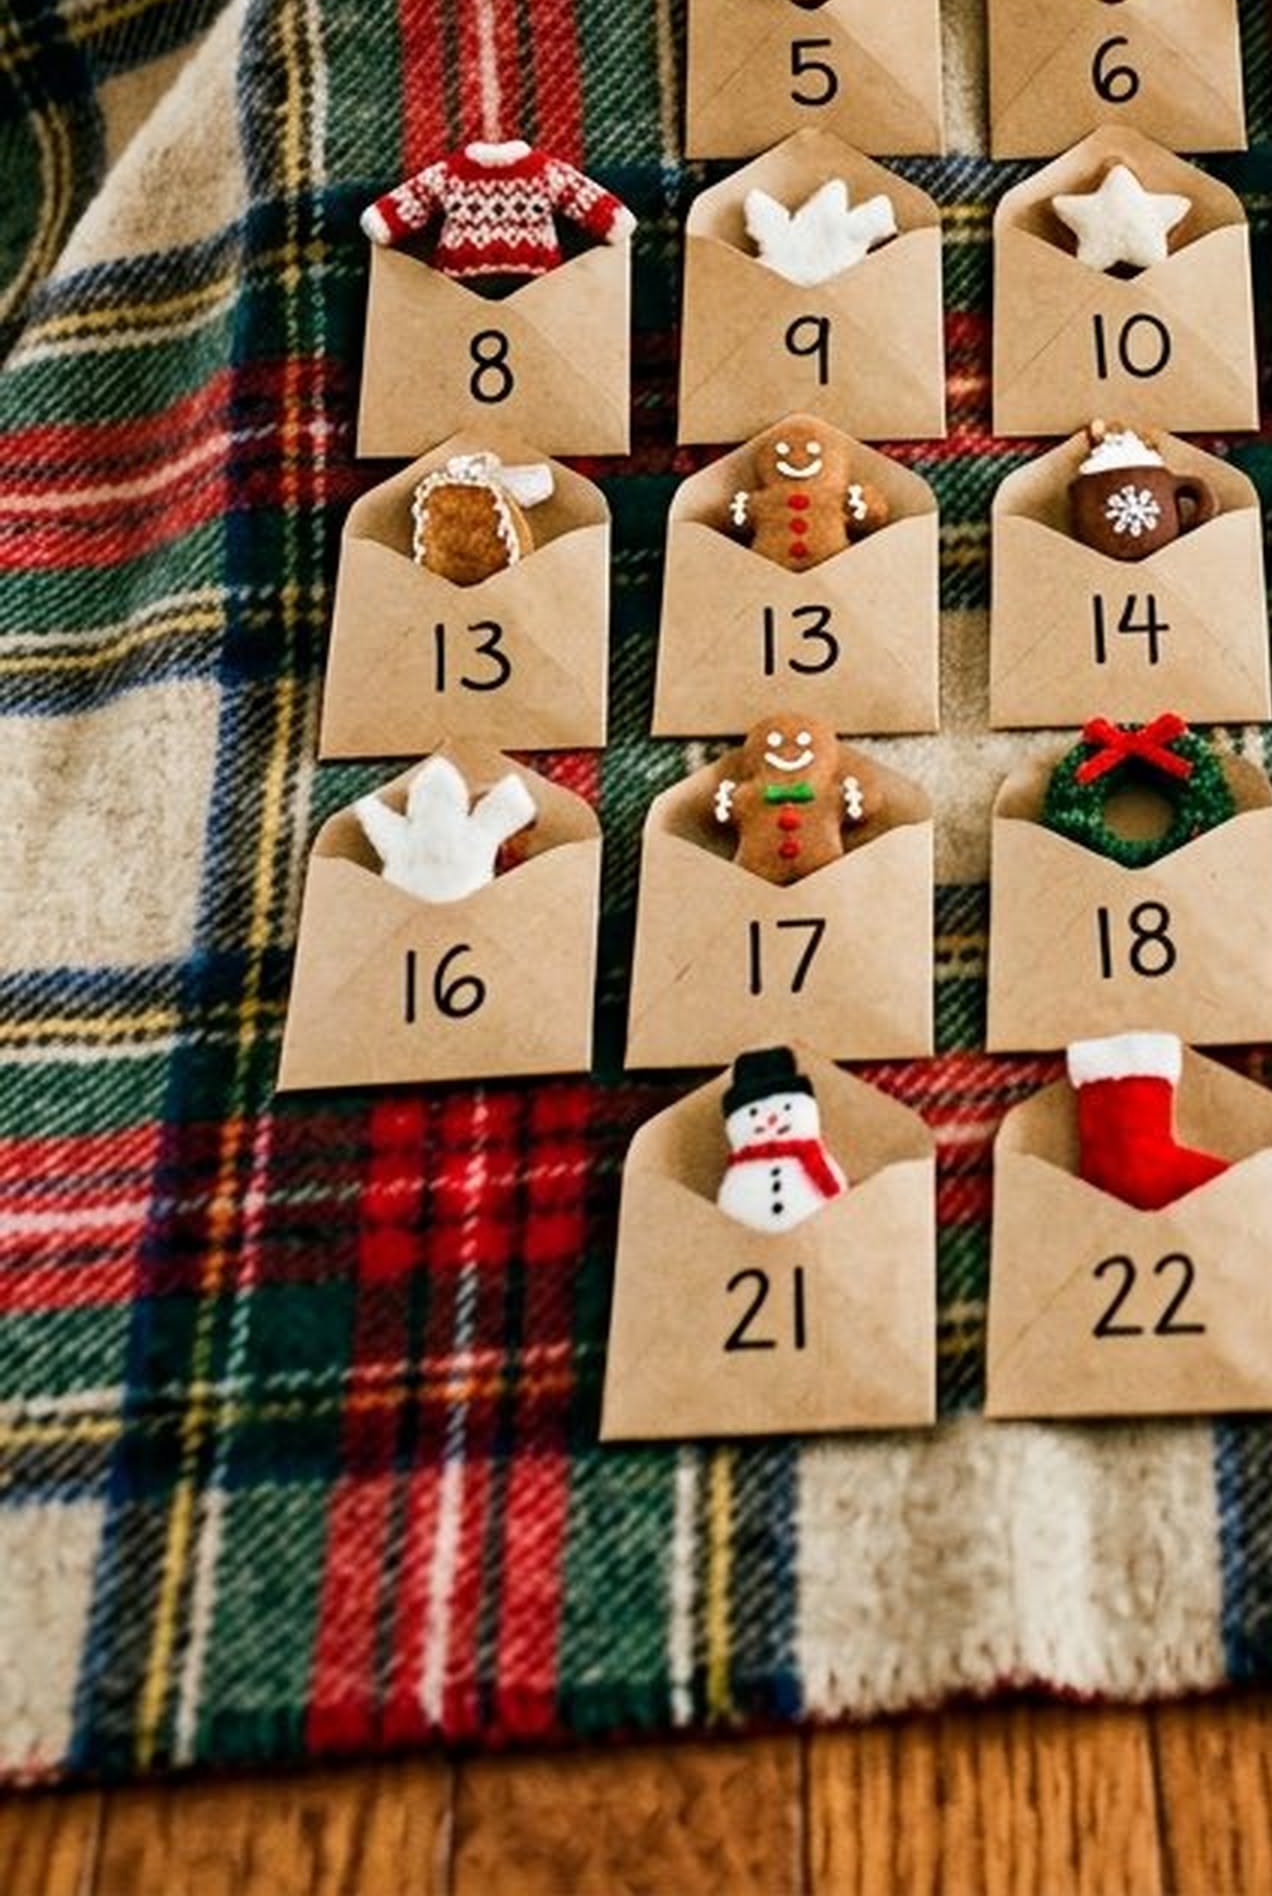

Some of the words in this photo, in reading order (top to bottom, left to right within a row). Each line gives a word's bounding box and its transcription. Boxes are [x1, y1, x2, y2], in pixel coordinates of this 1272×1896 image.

[790, 37, 839, 108] 5
[1090, 35, 1141, 105] 6
[468, 328, 515, 405] 8
[784, 314, 831, 387] 9
[1092, 312, 1172, 381] 10
[434, 619, 512, 693] 13
[763, 604, 840, 677] 13
[1092, 593, 1170, 666] 14
[748, 917, 827, 997] 17
[1096, 900, 1177, 980] 18
[404, 943, 487, 1025] 16
[722, 1265, 807, 1354] 21
[1091, 1252, 1207, 1340] 22
